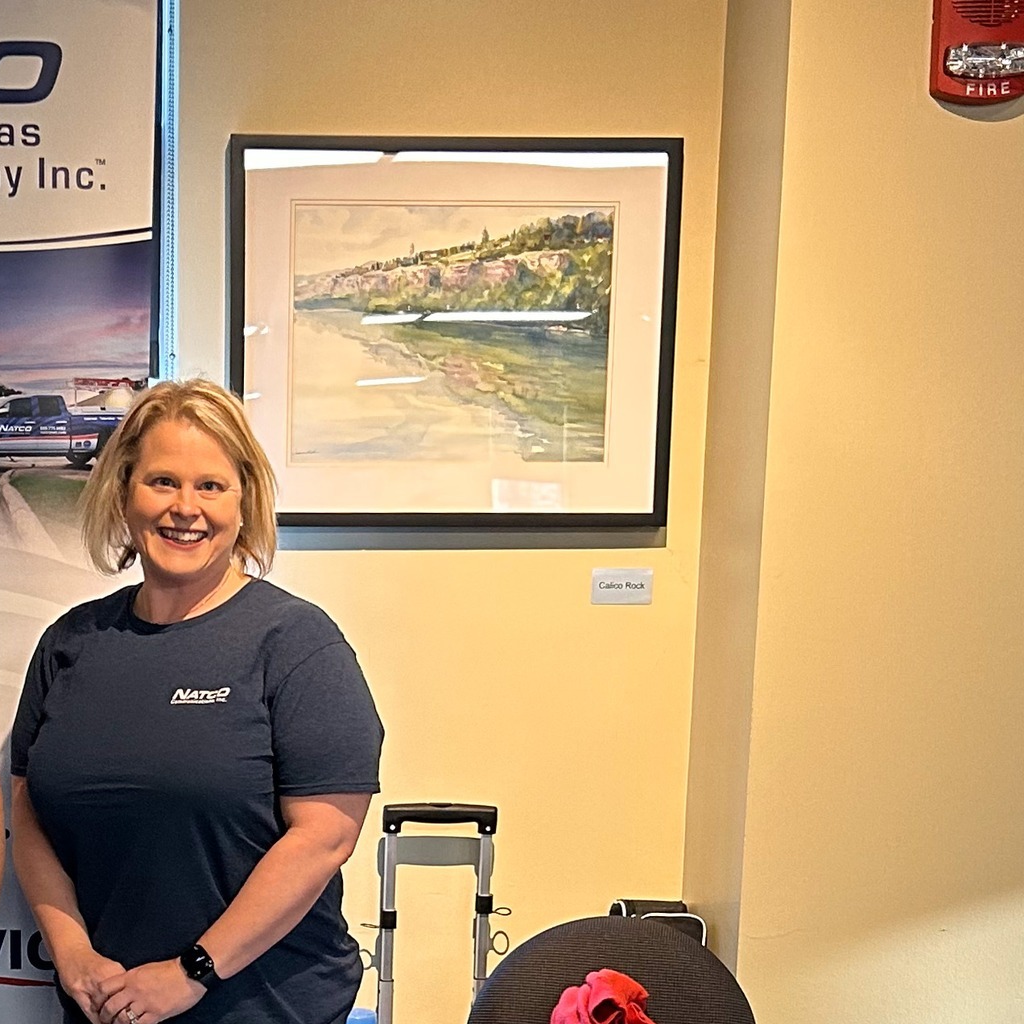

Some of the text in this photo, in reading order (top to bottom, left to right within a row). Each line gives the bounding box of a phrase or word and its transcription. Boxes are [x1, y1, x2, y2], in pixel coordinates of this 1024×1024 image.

[966, 81, 1011, 96] FIRE
[598, 581, 646, 590] Calico Rock
[171, 687, 231, 700] NATCO
